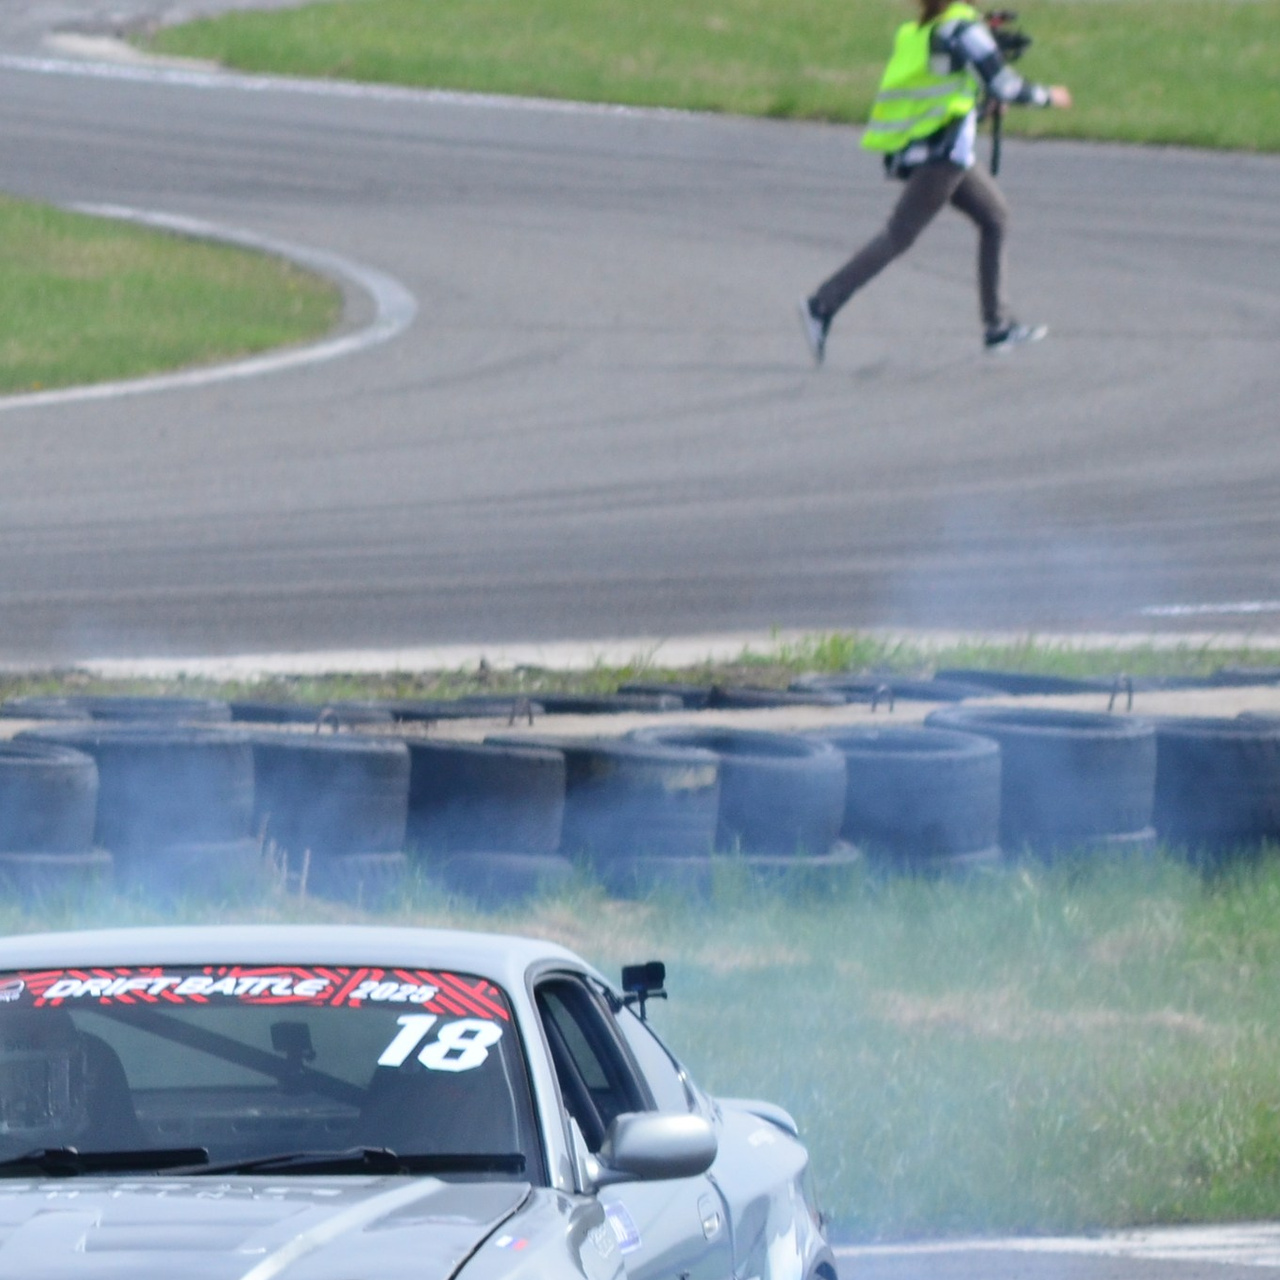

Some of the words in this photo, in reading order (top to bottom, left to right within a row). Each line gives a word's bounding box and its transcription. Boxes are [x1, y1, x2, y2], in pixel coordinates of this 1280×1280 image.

[43, 976, 181, 998] DRIFT
[173, 976, 330, 997] BATTLE
[349, 980, 439, 1003] 2025
[377, 1013, 503, 1073] 18
